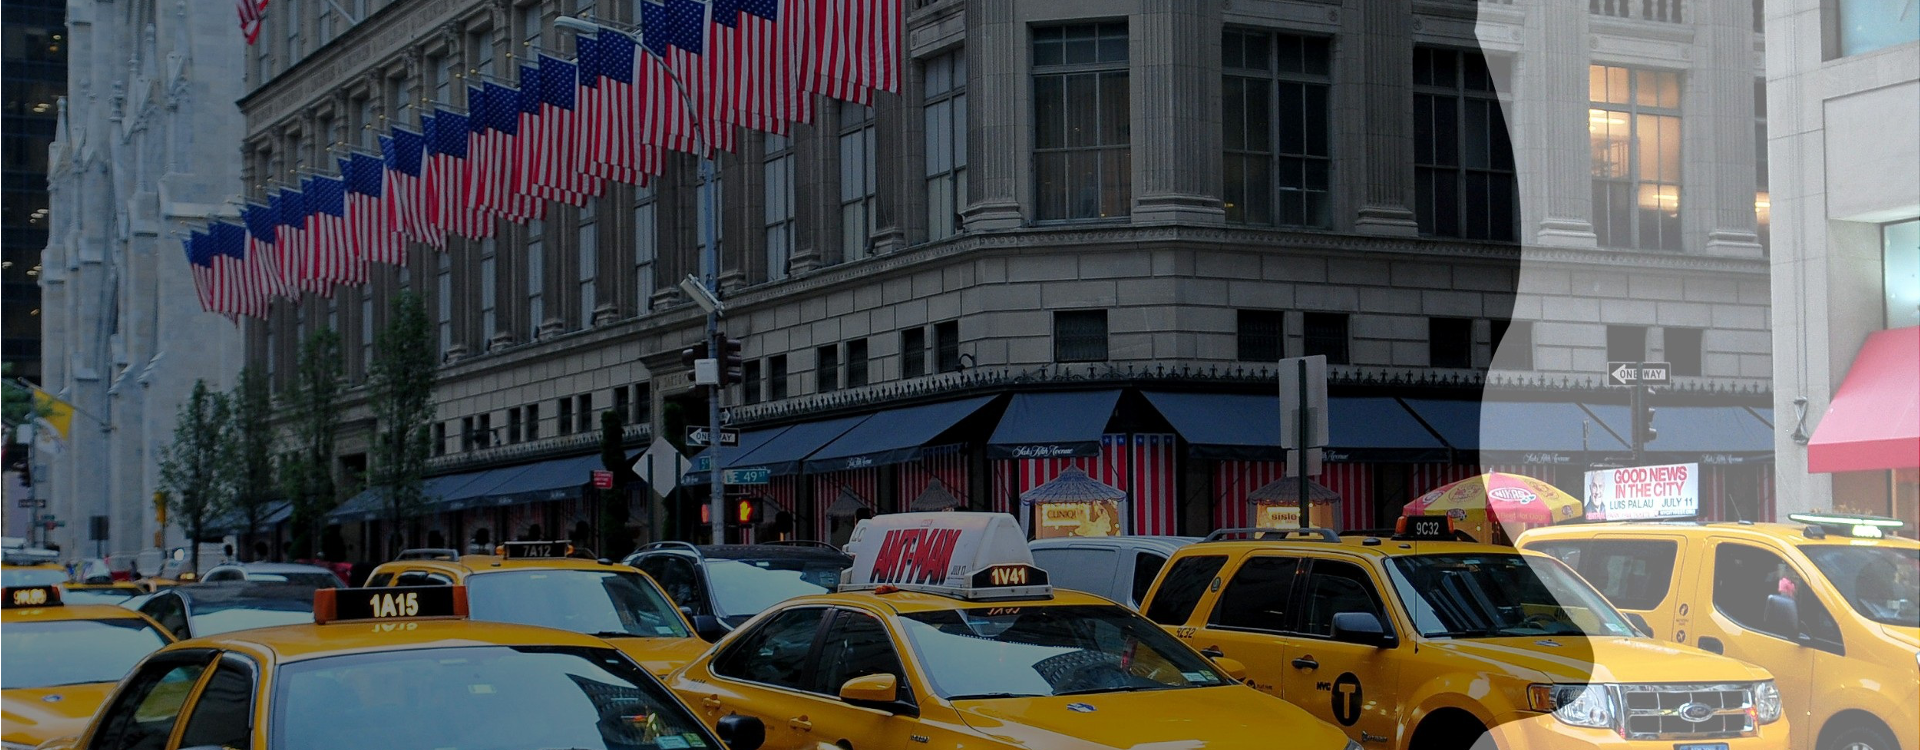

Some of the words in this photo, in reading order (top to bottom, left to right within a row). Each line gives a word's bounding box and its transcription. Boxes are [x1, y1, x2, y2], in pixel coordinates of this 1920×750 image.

[1620, 369, 1638, 379] ONE
[1643, 369, 1662, 379] WAY
[743, 471, 758, 483] 49
[1614, 469, 1648, 484] GOOD
[1649, 466, 1688, 481] NEWS
[1615, 484, 1626, 499] IN
[1628, 482, 1652, 498] THE
[1653, 481, 1685, 497] CITY
[1609, 499, 1626, 510] LUIS
[1627, 499, 1654, 509] PALAU
[1661, 497, 1683, 508] JULY
[1684, 497, 1693, 507] 11
[1416, 521, 1439, 535] 9C32
[523, 544, 551, 557] 7A12
[869, 528, 963, 586] ANT-MAN
[991, 567, 1026, 586] 1V41
[369, 592, 419, 618] 1A15
[1316, 681, 1331, 691] NYC
[1338, 682, 1357, 720] T
